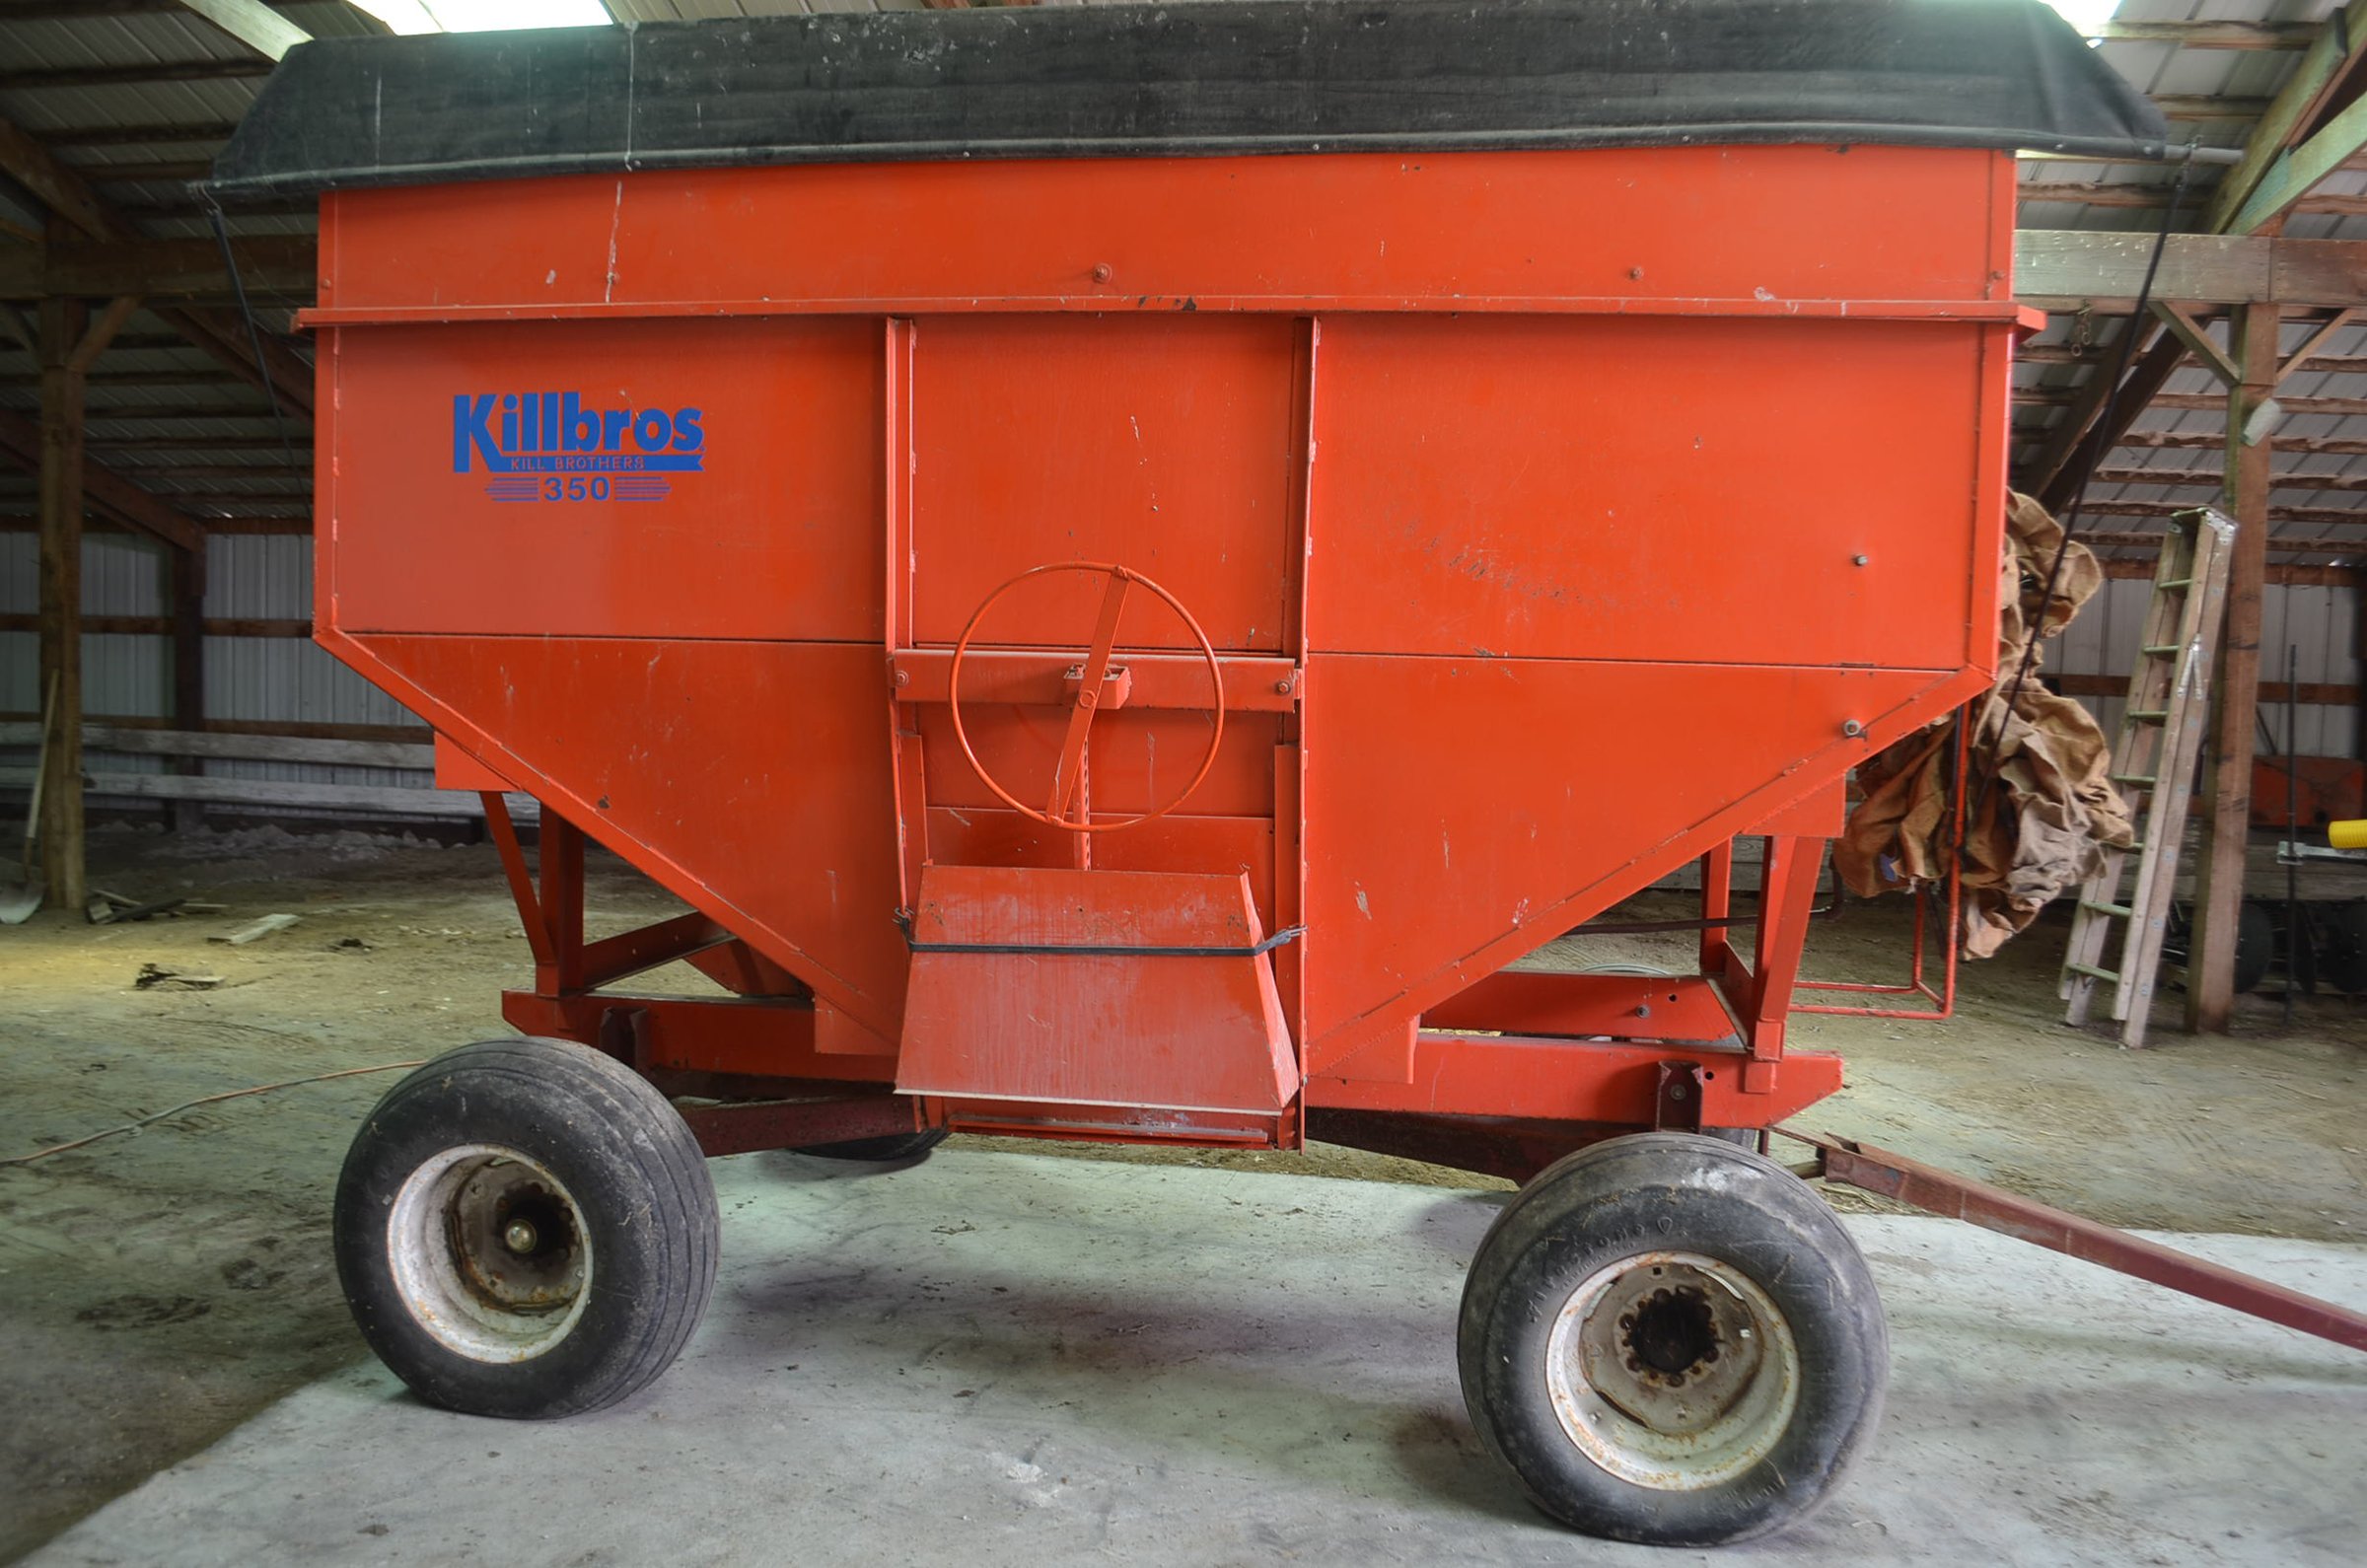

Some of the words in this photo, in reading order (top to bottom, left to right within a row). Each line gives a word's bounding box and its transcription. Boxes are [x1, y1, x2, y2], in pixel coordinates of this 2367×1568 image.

[453, 392, 704, 472] Killbros
[511, 456, 545, 470] KILL
[555, 456, 645, 470] BROTHERS
[543, 476, 610, 501] 350
